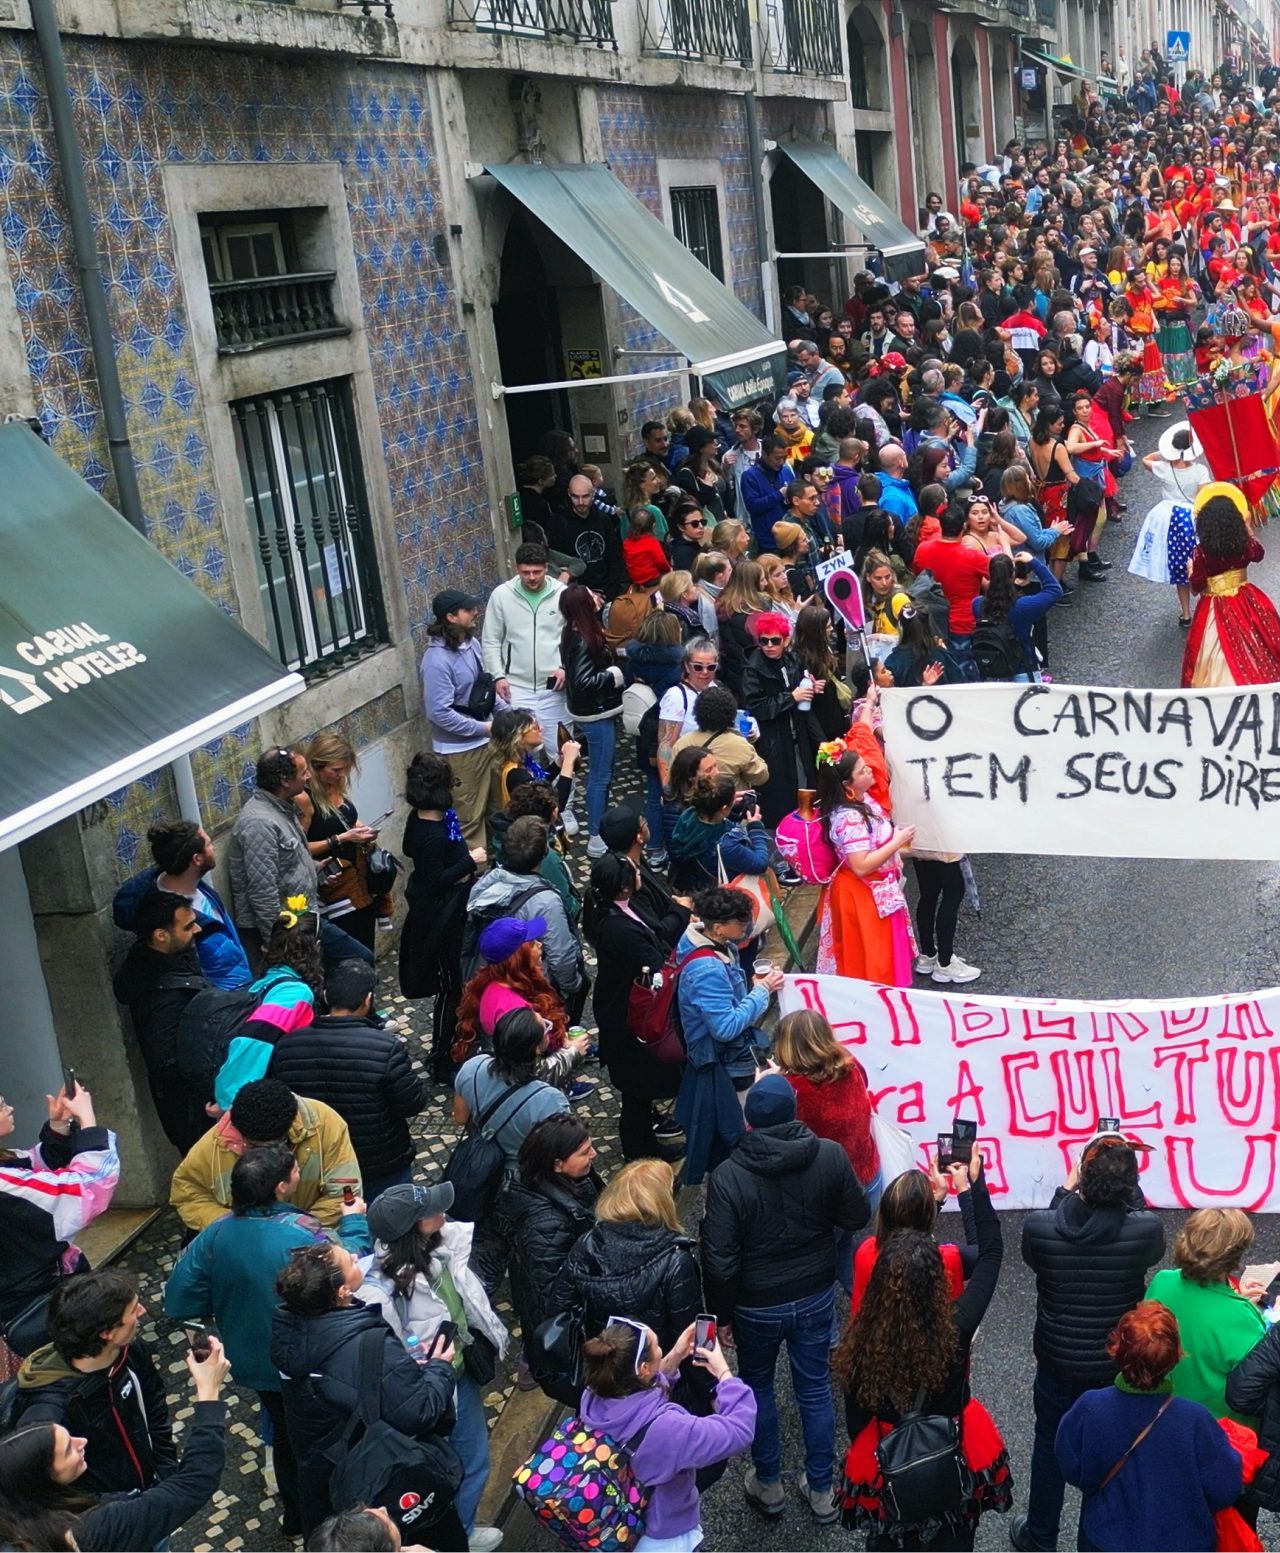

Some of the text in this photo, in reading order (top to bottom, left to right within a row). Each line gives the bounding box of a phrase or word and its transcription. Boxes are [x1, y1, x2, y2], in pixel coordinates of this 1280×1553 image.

[822, 555, 846, 575] ZYN
[906, 694, 953, 742] O
[906, 752, 1032, 805] TEM
[1056, 752, 1184, 800] SEUS
[946, 1059, 985, 1127] A
